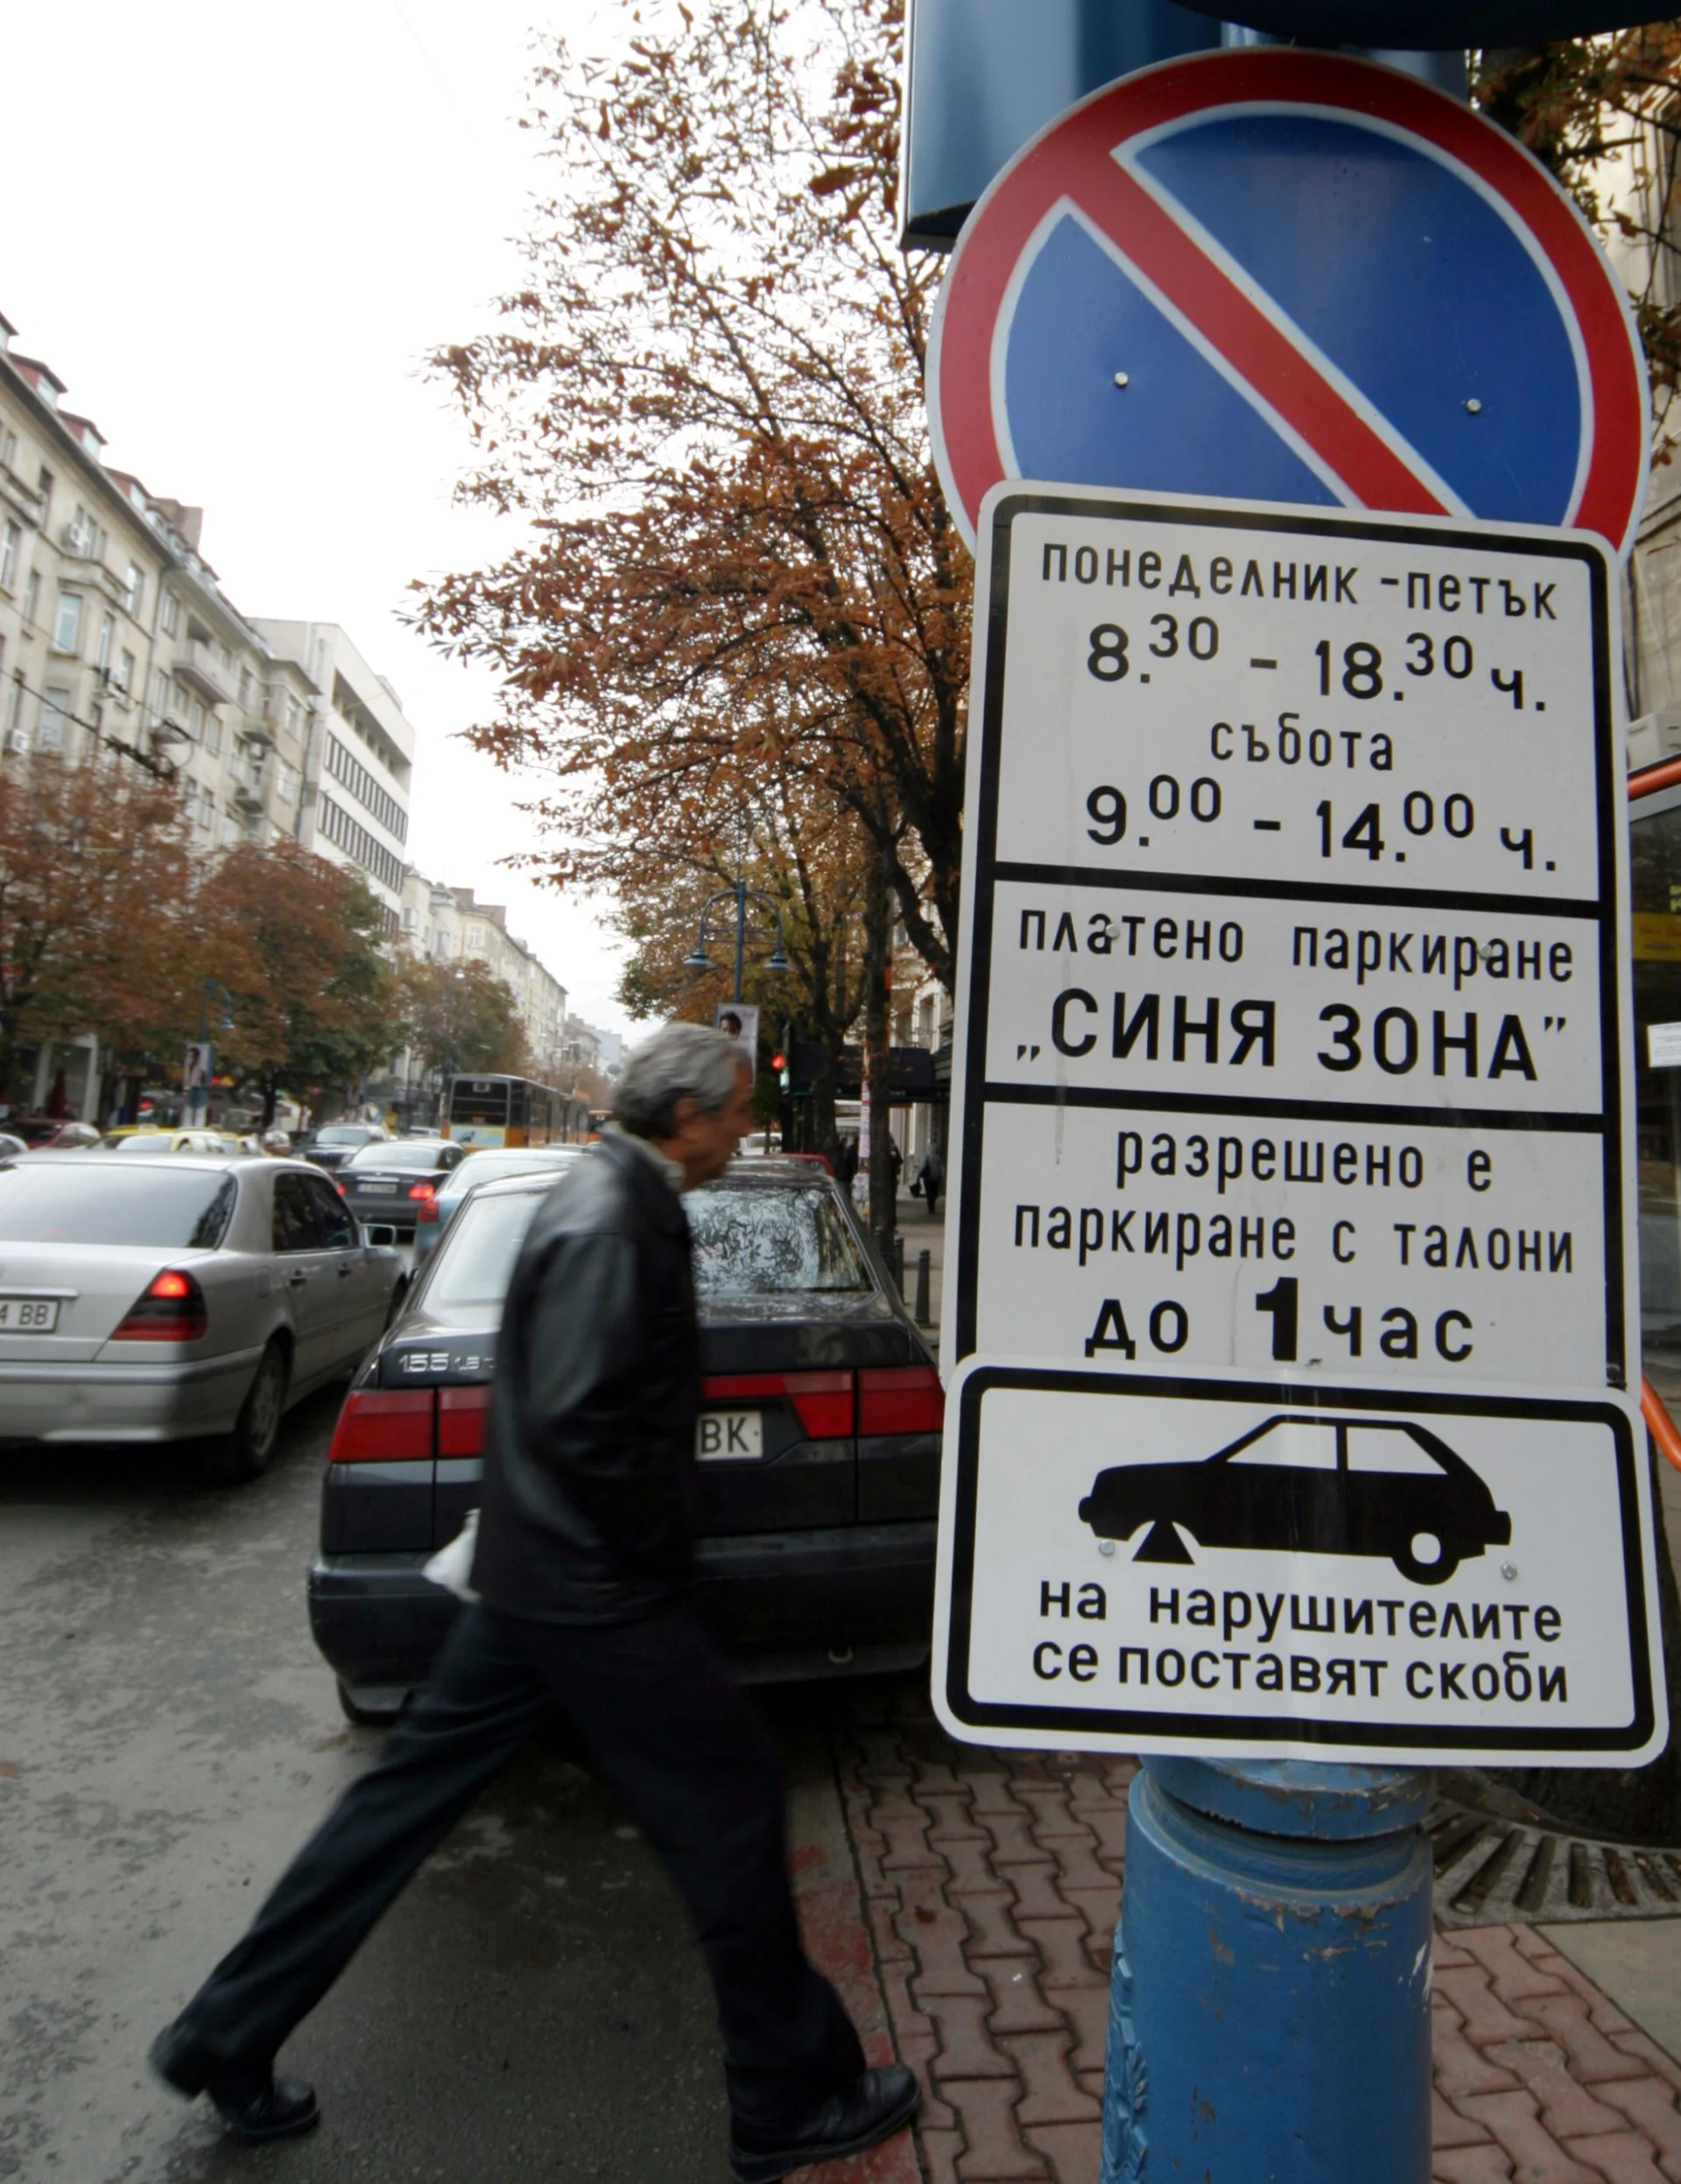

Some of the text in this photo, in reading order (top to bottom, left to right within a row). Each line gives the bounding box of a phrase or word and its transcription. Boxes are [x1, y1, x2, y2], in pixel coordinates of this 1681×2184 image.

[1042, 543, 1359, 605] понеделник
[1490, 668, 1547, 712] ч.
[1211, 712, 1394, 771] събота
[1500, 826, 1557, 872] ч.
[1019, 909, 1573, 992] платено паркиране
[1116, 1131, 1493, 1195] разрешено е
[1014, 1204, 1573, 1274] паркиране с талони
[1084, 1276, 1474, 1363] до 1 час
[398, 1353, 449, 1373] 155
[700, 1417, 750, 1455] BK
[1040, 1580, 1563, 1643] на нарушителите
[1032, 1641, 1568, 1703] се поставят скоби
